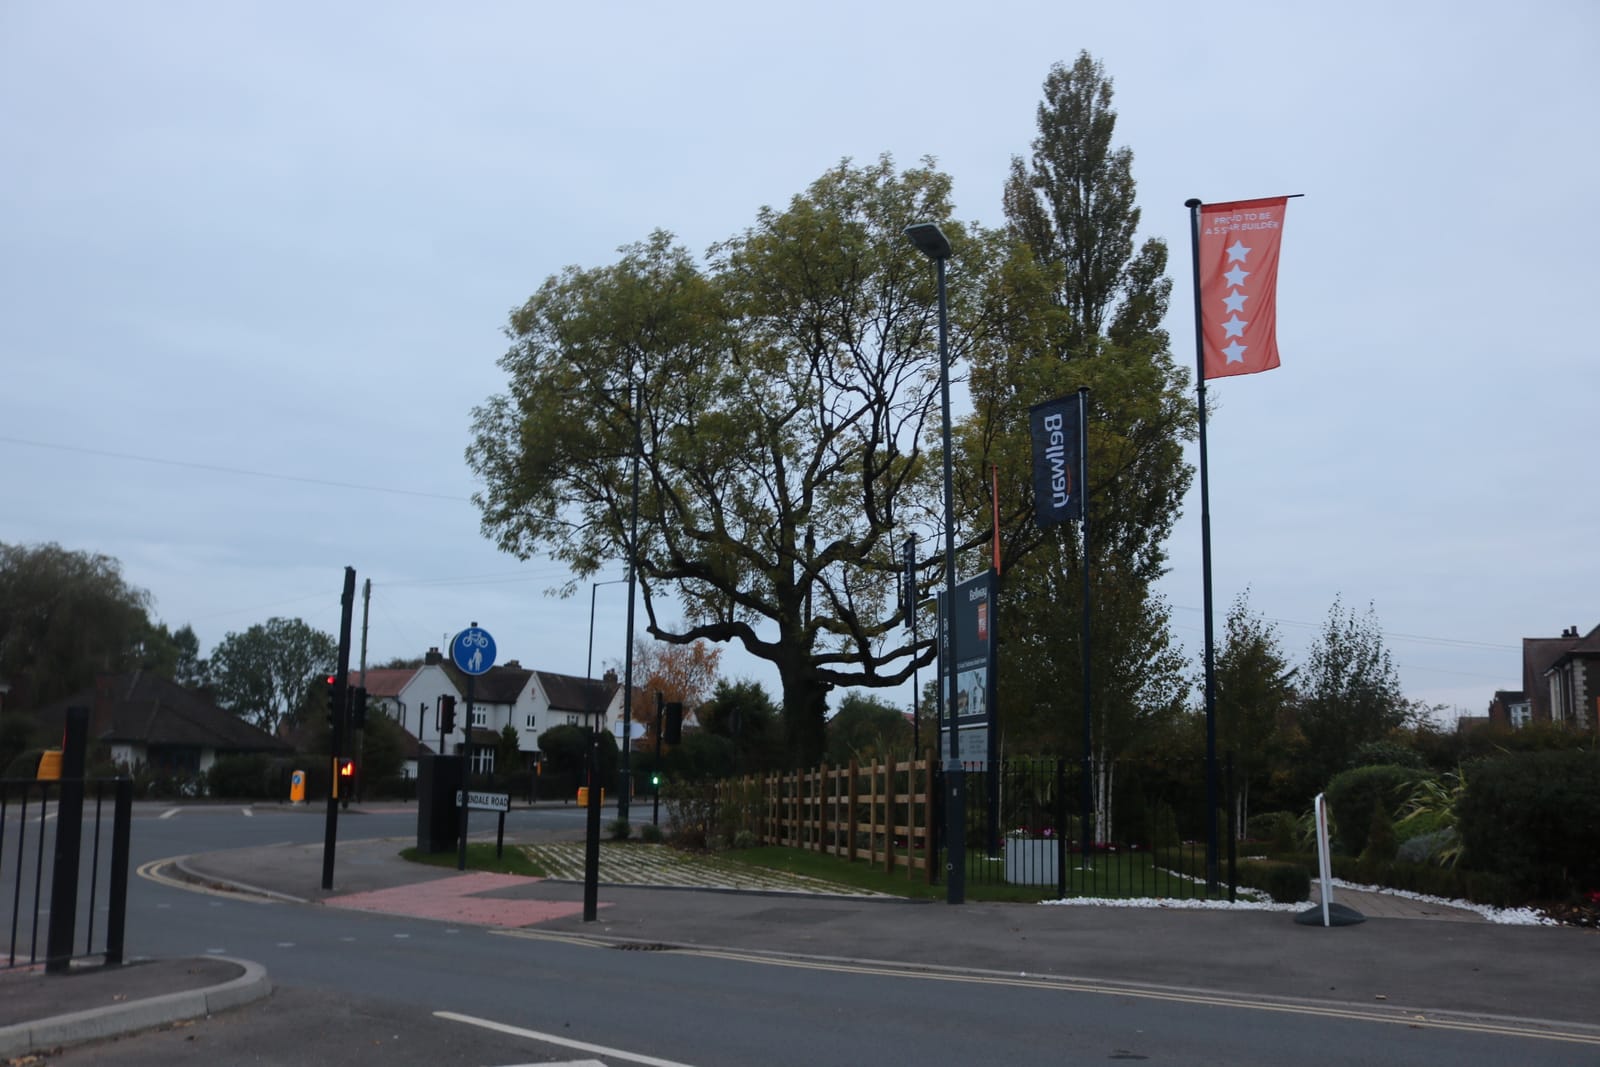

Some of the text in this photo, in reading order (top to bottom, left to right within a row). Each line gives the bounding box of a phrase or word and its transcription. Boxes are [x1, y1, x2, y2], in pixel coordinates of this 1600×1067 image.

[1244, 213, 1257, 221] TO
[1258, 212, 1272, 220] BE
[1241, 220, 1279, 231] BUILDER
[457, 794, 508, 807] GENDALE ROAD
